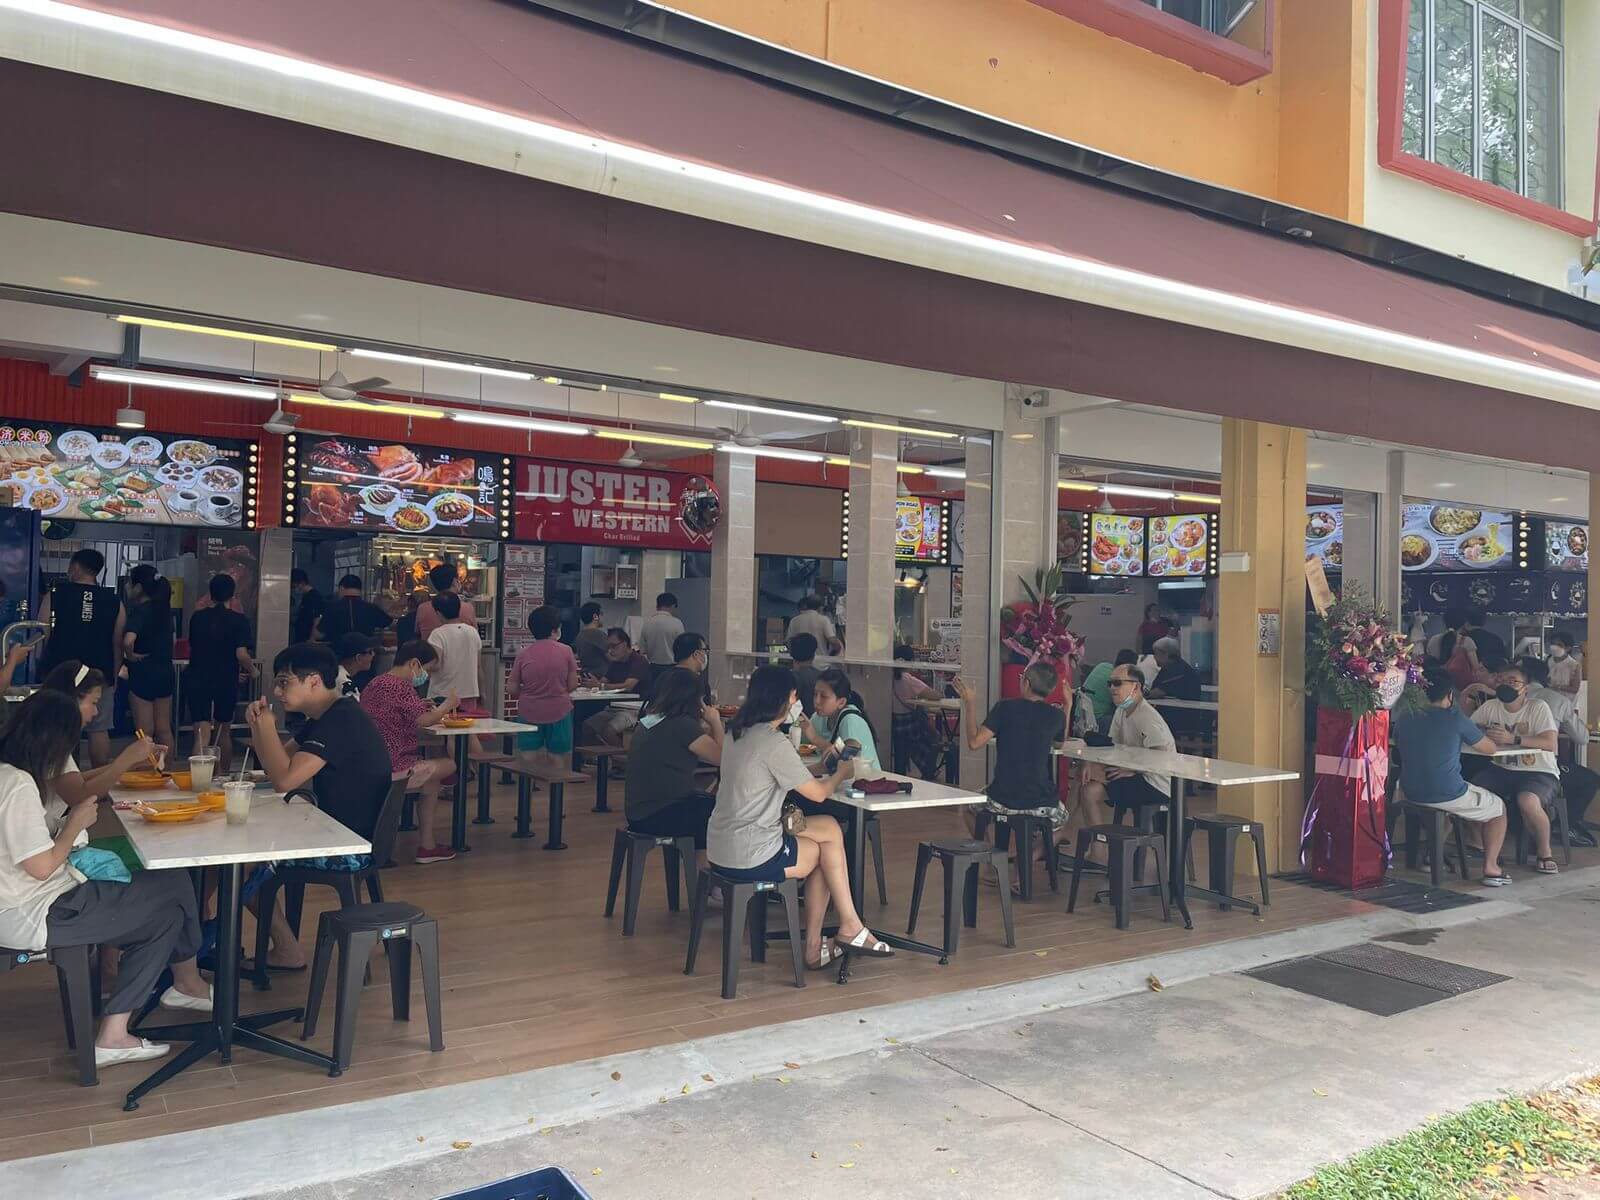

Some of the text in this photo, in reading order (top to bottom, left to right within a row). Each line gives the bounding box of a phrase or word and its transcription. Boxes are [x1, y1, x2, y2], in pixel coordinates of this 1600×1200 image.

[524, 464, 671, 511] JUSTER
[572, 508, 670, 533] WESTERN
[83, 591, 93, 600] 23
